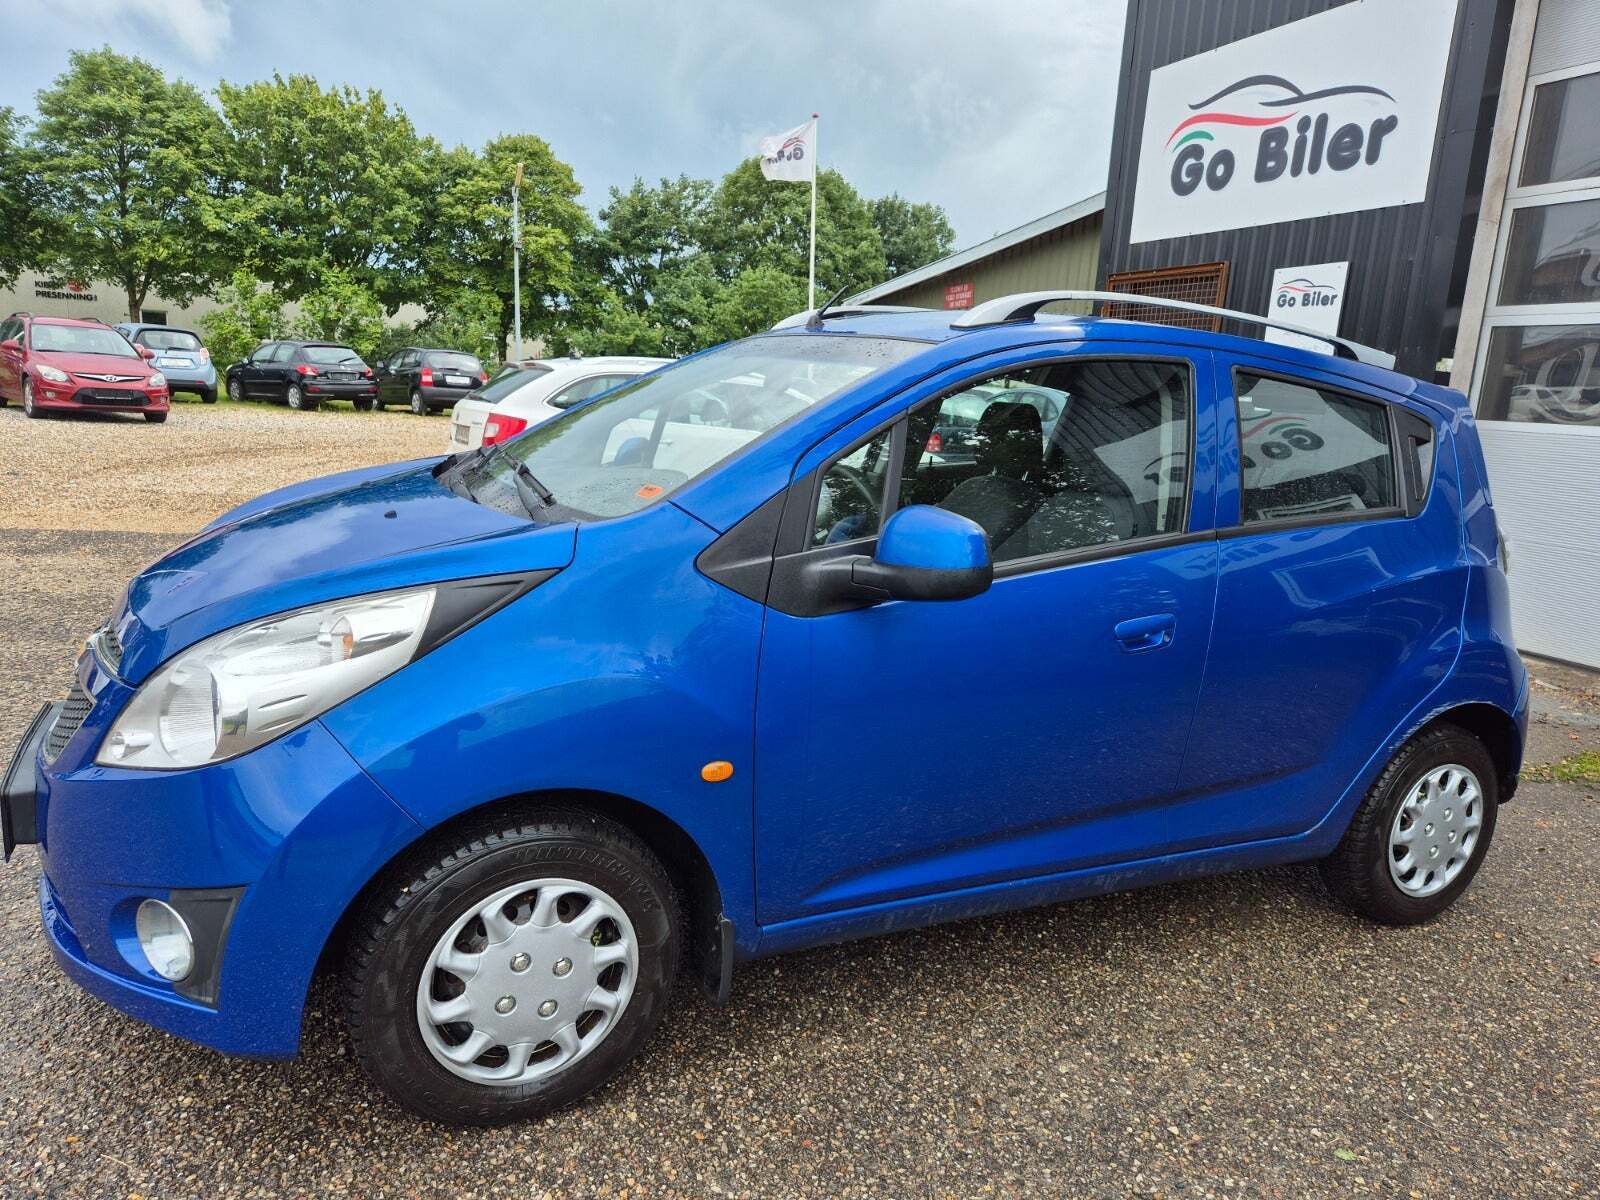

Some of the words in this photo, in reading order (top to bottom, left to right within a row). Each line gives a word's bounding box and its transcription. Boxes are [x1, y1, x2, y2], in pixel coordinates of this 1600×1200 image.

[1171, 143, 1235, 196] Go
[1254, 112, 1398, 183] Biler
[35, 290, 93, 301] PRESENNING
[1277, 293, 1296, 308] Go
[1301, 290, 1338, 307] Biler
